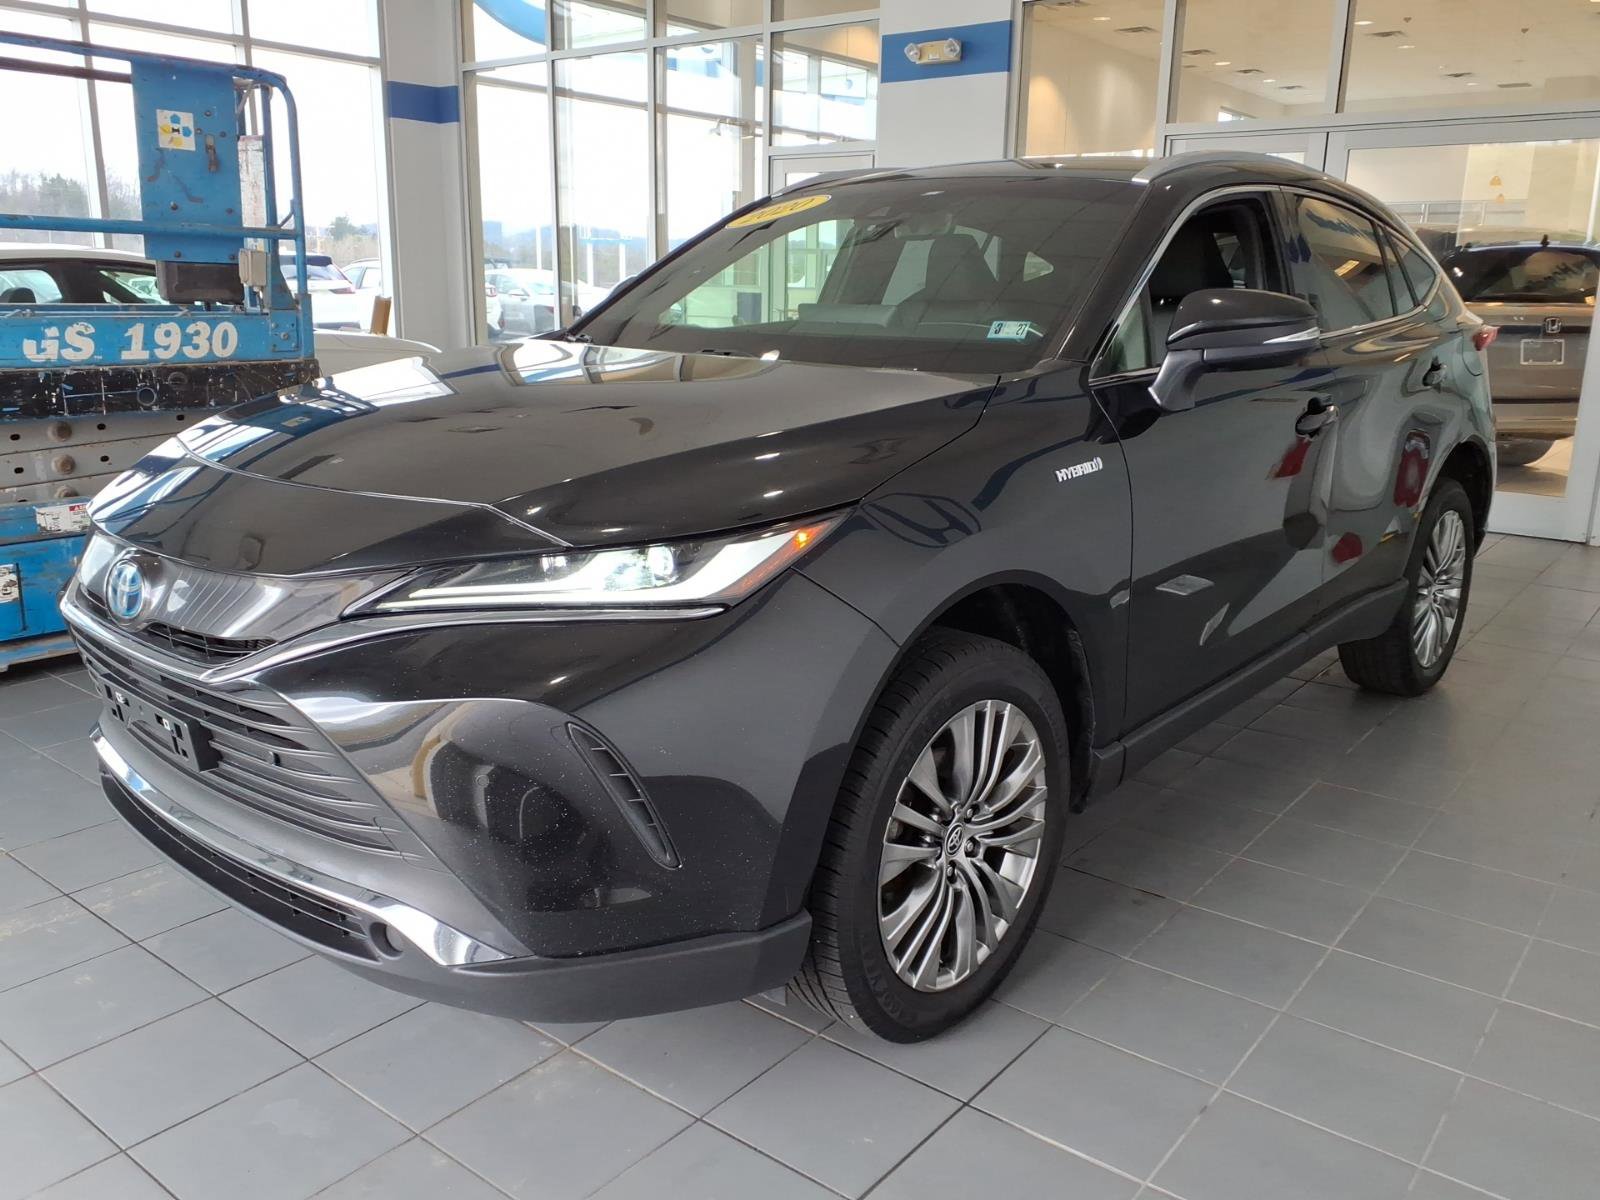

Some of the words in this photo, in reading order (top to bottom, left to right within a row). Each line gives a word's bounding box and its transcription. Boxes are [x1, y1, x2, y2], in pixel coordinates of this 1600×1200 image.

[738, 197, 817, 224] 2020
[121, 321, 238, 359] 1930
[1016, 323, 1028, 336] 27
[1055, 460, 1099, 482] HYBRID
